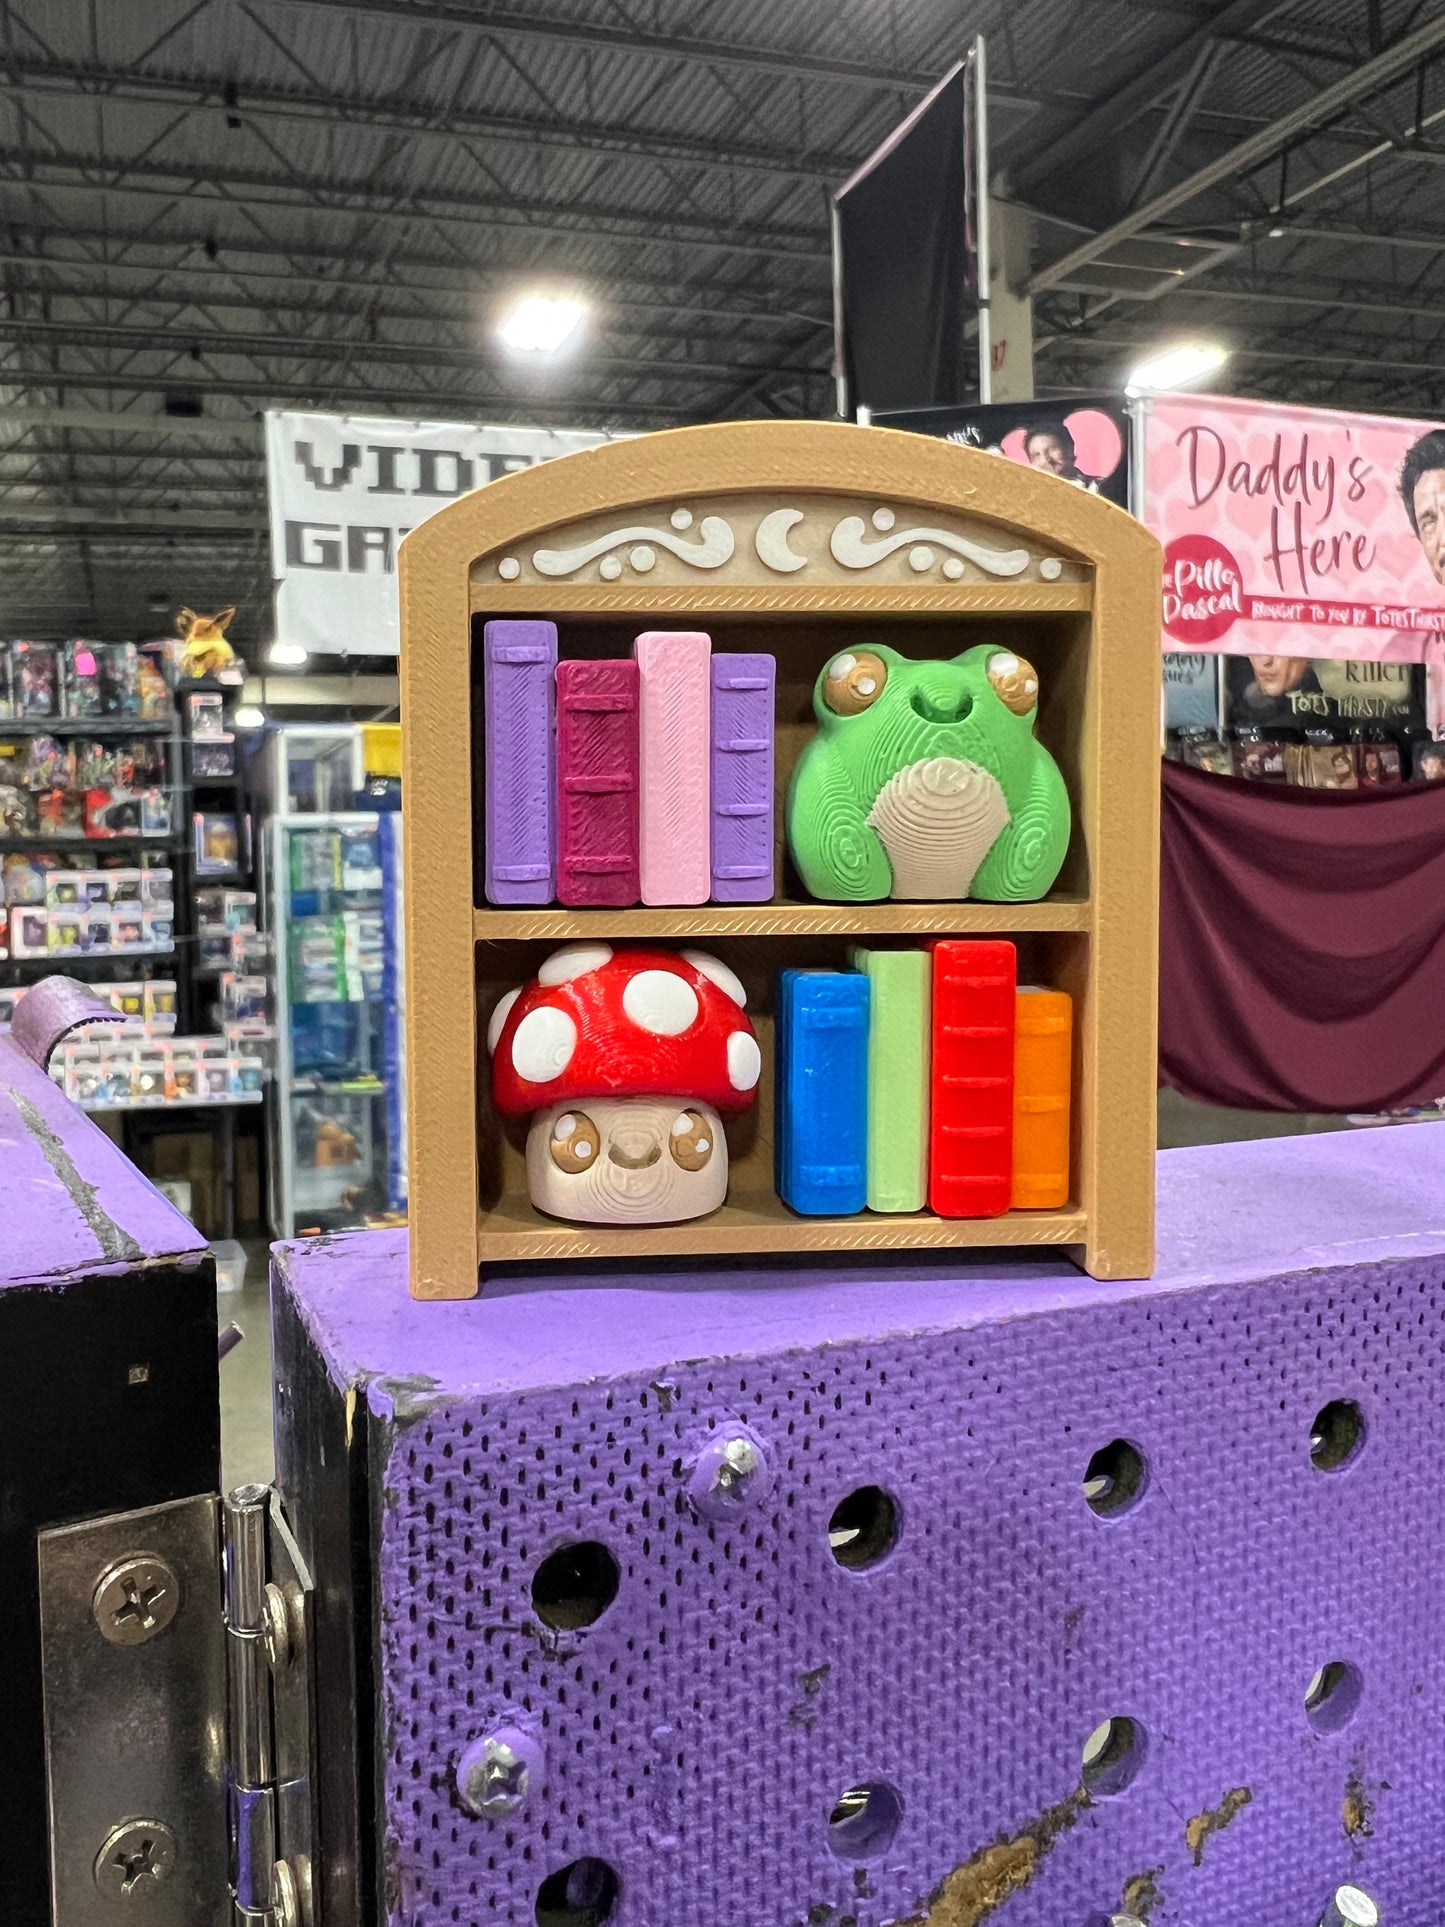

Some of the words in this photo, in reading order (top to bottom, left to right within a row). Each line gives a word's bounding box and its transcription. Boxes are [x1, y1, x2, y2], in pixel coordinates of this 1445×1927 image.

[1175, 425, 1374, 524] Daddy's
[285, 520, 411, 574] GA
[1263, 501, 1377, 595] Here
[1162, 579, 1242, 625] Pascal
